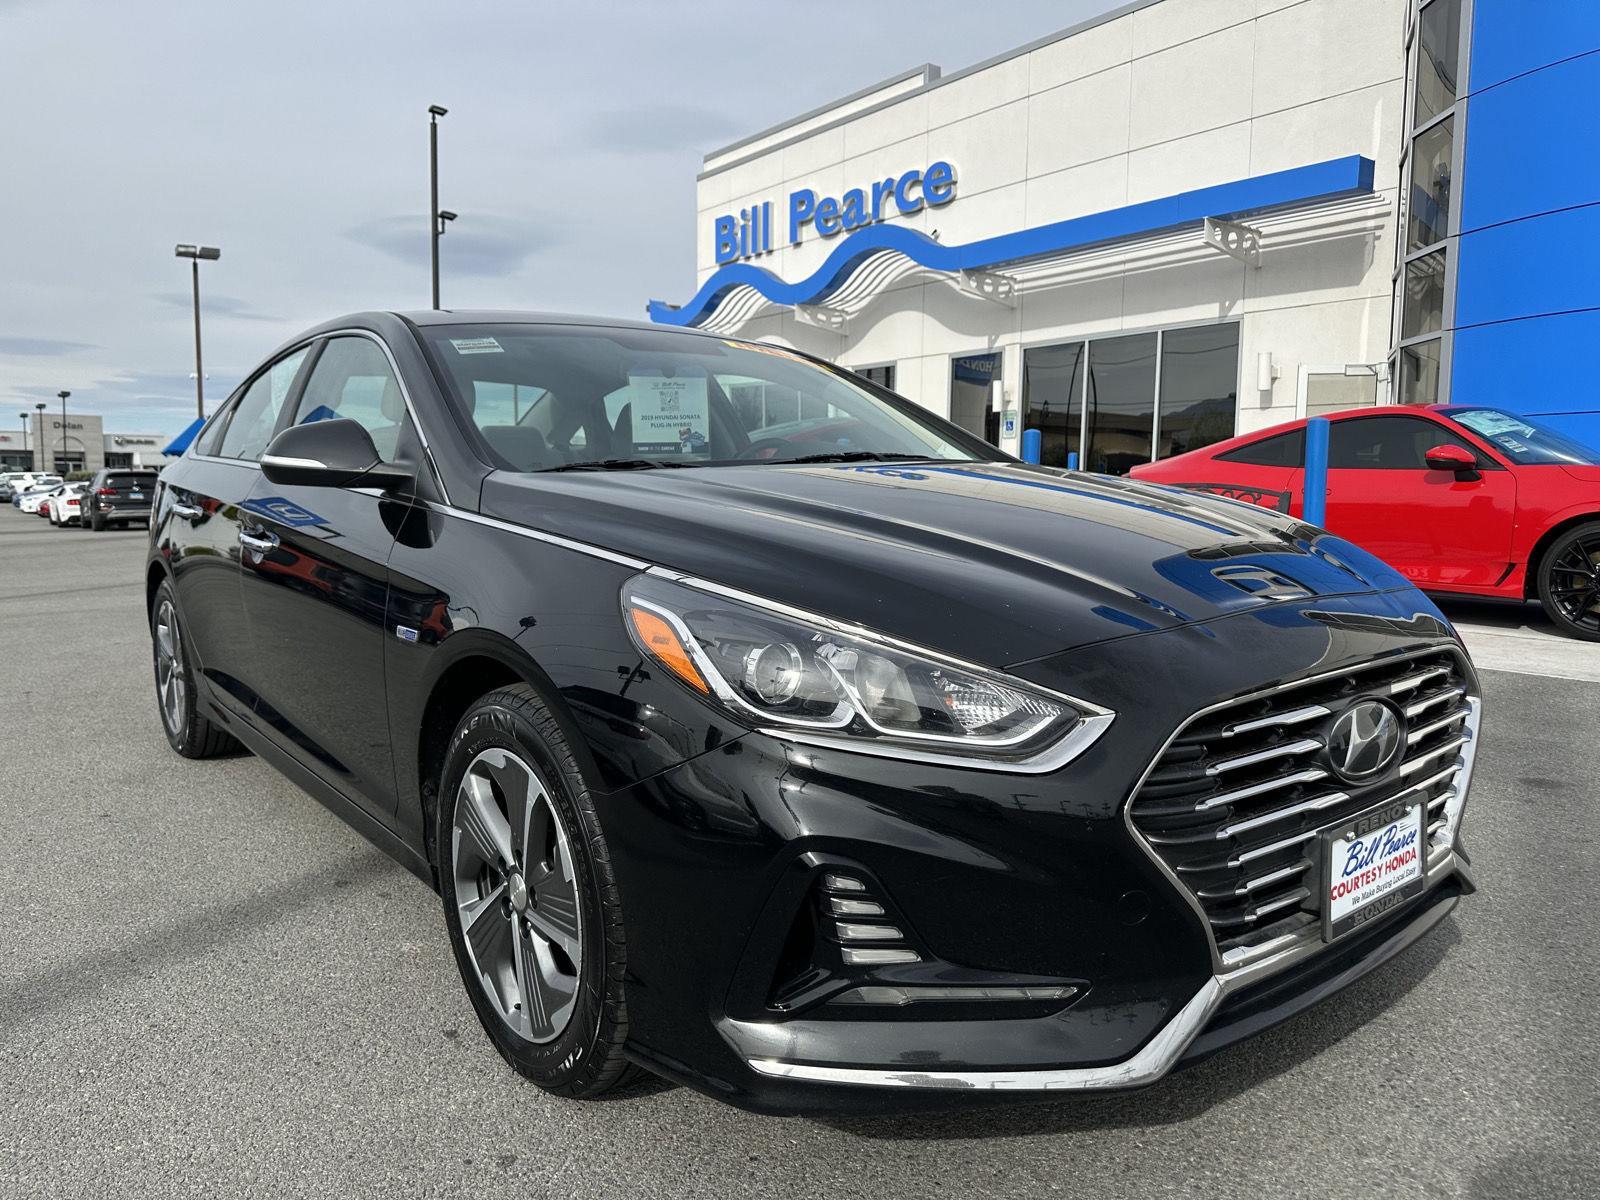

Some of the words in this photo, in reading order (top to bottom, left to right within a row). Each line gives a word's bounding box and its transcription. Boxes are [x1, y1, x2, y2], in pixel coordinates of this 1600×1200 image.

[715, 201, 772, 265] Bill
[789, 161, 956, 245] Pearce
[1357, 804, 1404, 835] RENO
[1330, 863, 1384, 901] COURTESY
[1384, 846, 1417, 875] HONDA
[1341, 834, 1383, 878] Bill
[1379, 824, 1417, 860] Pearce
[1351, 895, 1361, 906] We
[1361, 888, 1376, 901] Make
[1375, 879, 1393, 895] Buying
[1392, 870, 1406, 885] Local
[1405, 866, 1417, 878] Easy
[1353, 890, 1405, 927] HONDA
